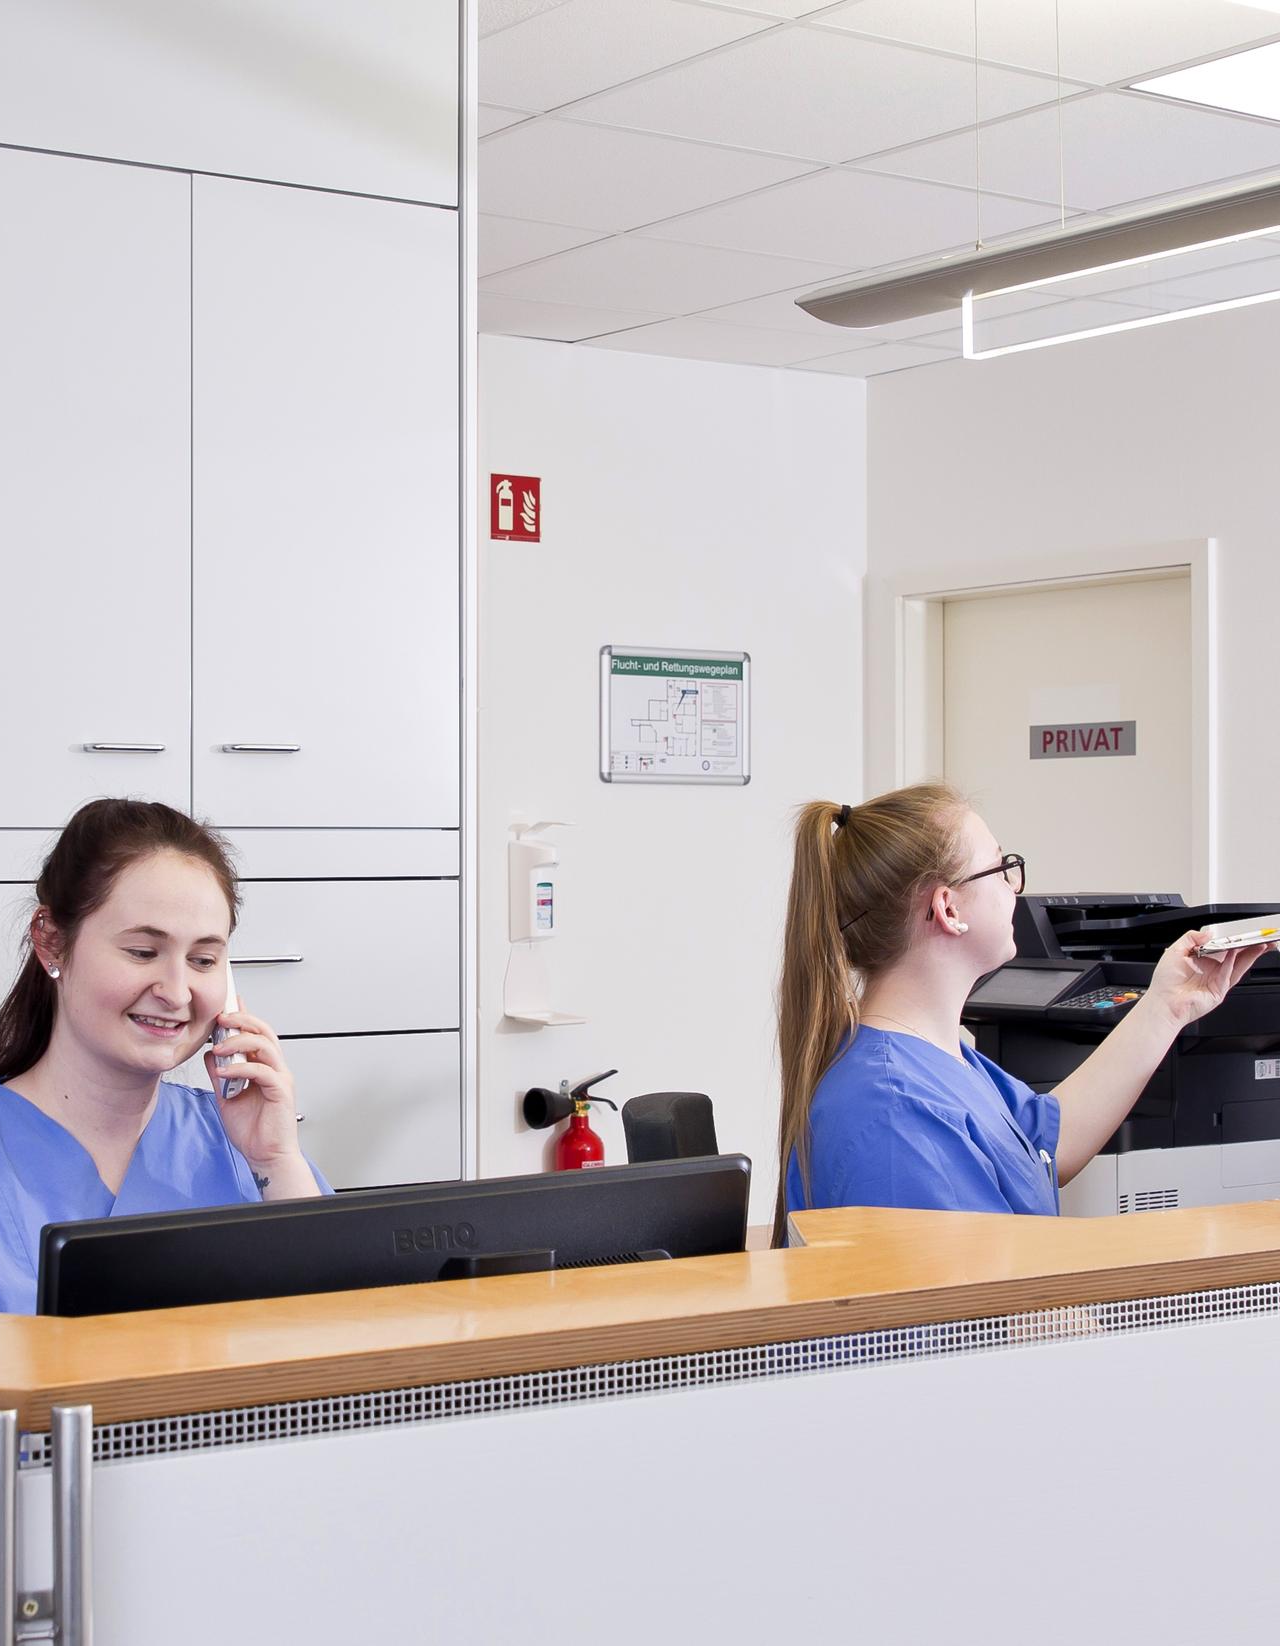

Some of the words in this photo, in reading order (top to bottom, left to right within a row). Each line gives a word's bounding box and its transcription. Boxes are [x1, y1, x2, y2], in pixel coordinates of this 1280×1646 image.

[611, 658, 641, 670] Flucht-
[643, 660, 659, 671] und
[661, 661, 738, 676] Rettungswegeplan
[1042, 727, 1124, 753] PRIVAT
[392, 1222, 480, 1256] BenQ
